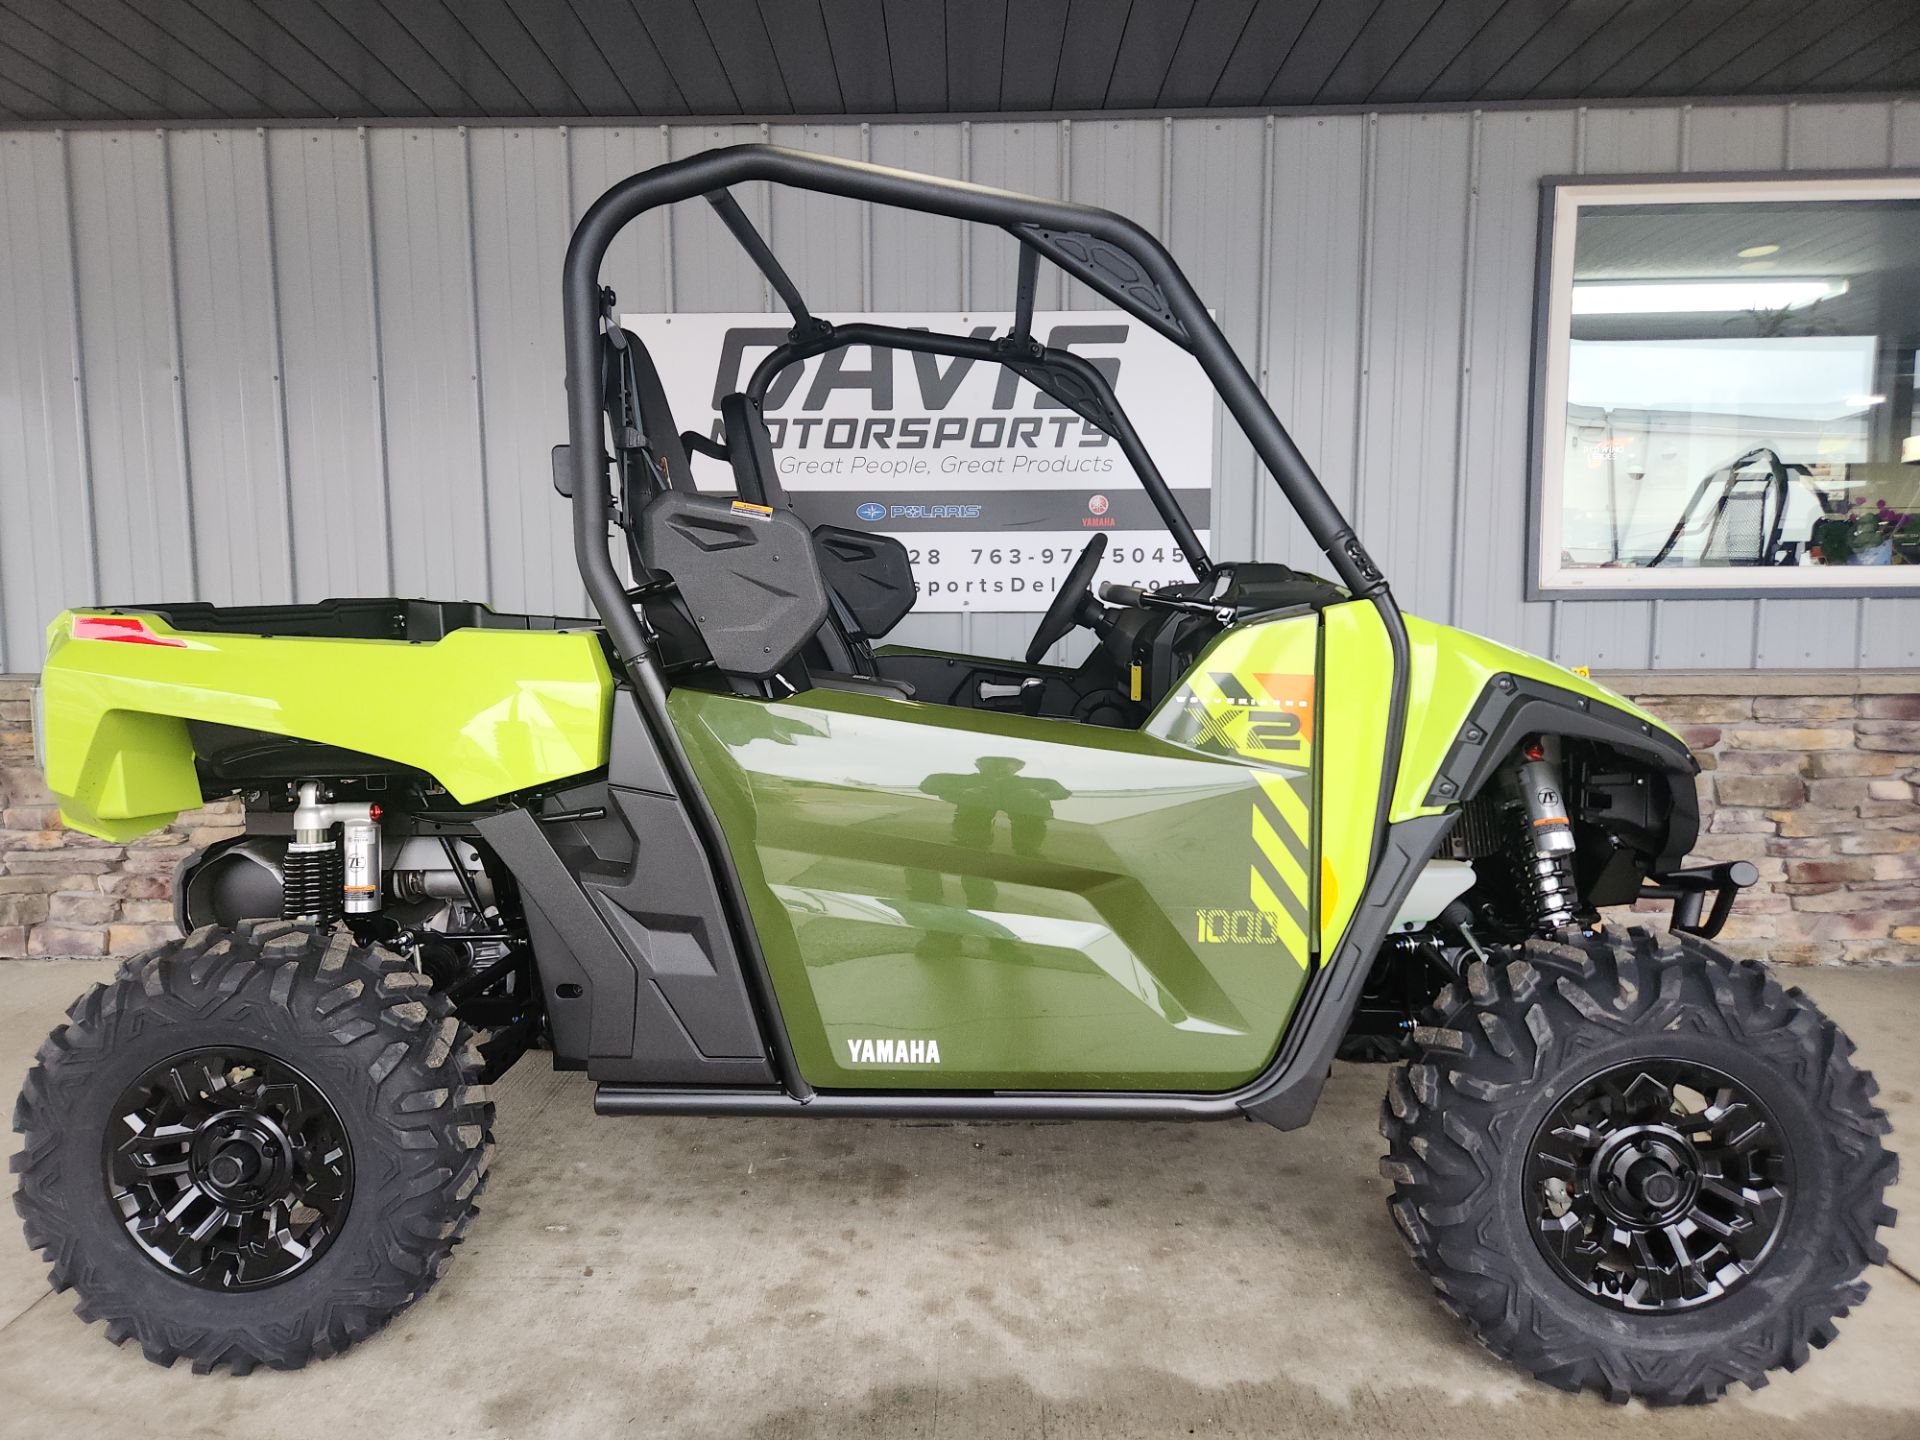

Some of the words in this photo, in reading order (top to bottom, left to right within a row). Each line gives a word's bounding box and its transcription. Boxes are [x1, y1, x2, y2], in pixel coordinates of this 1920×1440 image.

[779, 456, 843, 474] Great
[850, 456, 931, 478] People,
[941, 456, 1005, 473] Great
[1012, 455, 1114, 473] Products
[890, 505, 980, 519] POLARIS
[1081, 517, 1116, 527] YAMAHA
[971, 548, 1185, 564] 763-97-5045
[1183, 708, 1302, 751] X2
[1196, 908, 1278, 944] 1000
[847, 1039, 941, 1064] YAMAHA
